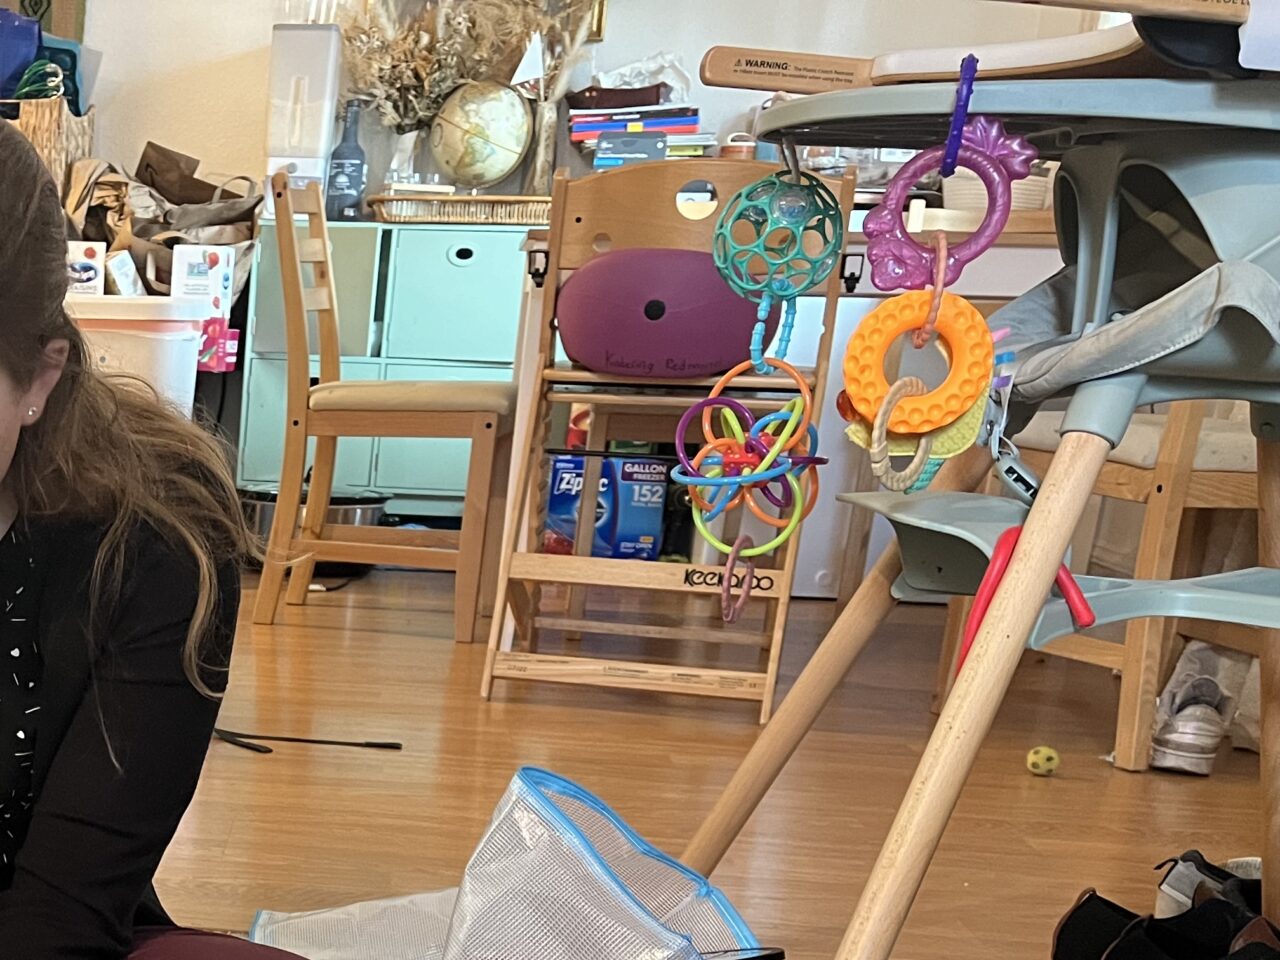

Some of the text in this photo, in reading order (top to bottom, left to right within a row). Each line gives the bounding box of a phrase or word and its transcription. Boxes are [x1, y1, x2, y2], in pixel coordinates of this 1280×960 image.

[745, 59, 791, 71] WARNING:
[624, 463, 667, 474] GALLON
[559, 473, 608, 495] Zipc
[632, 484, 663, 502] 152
